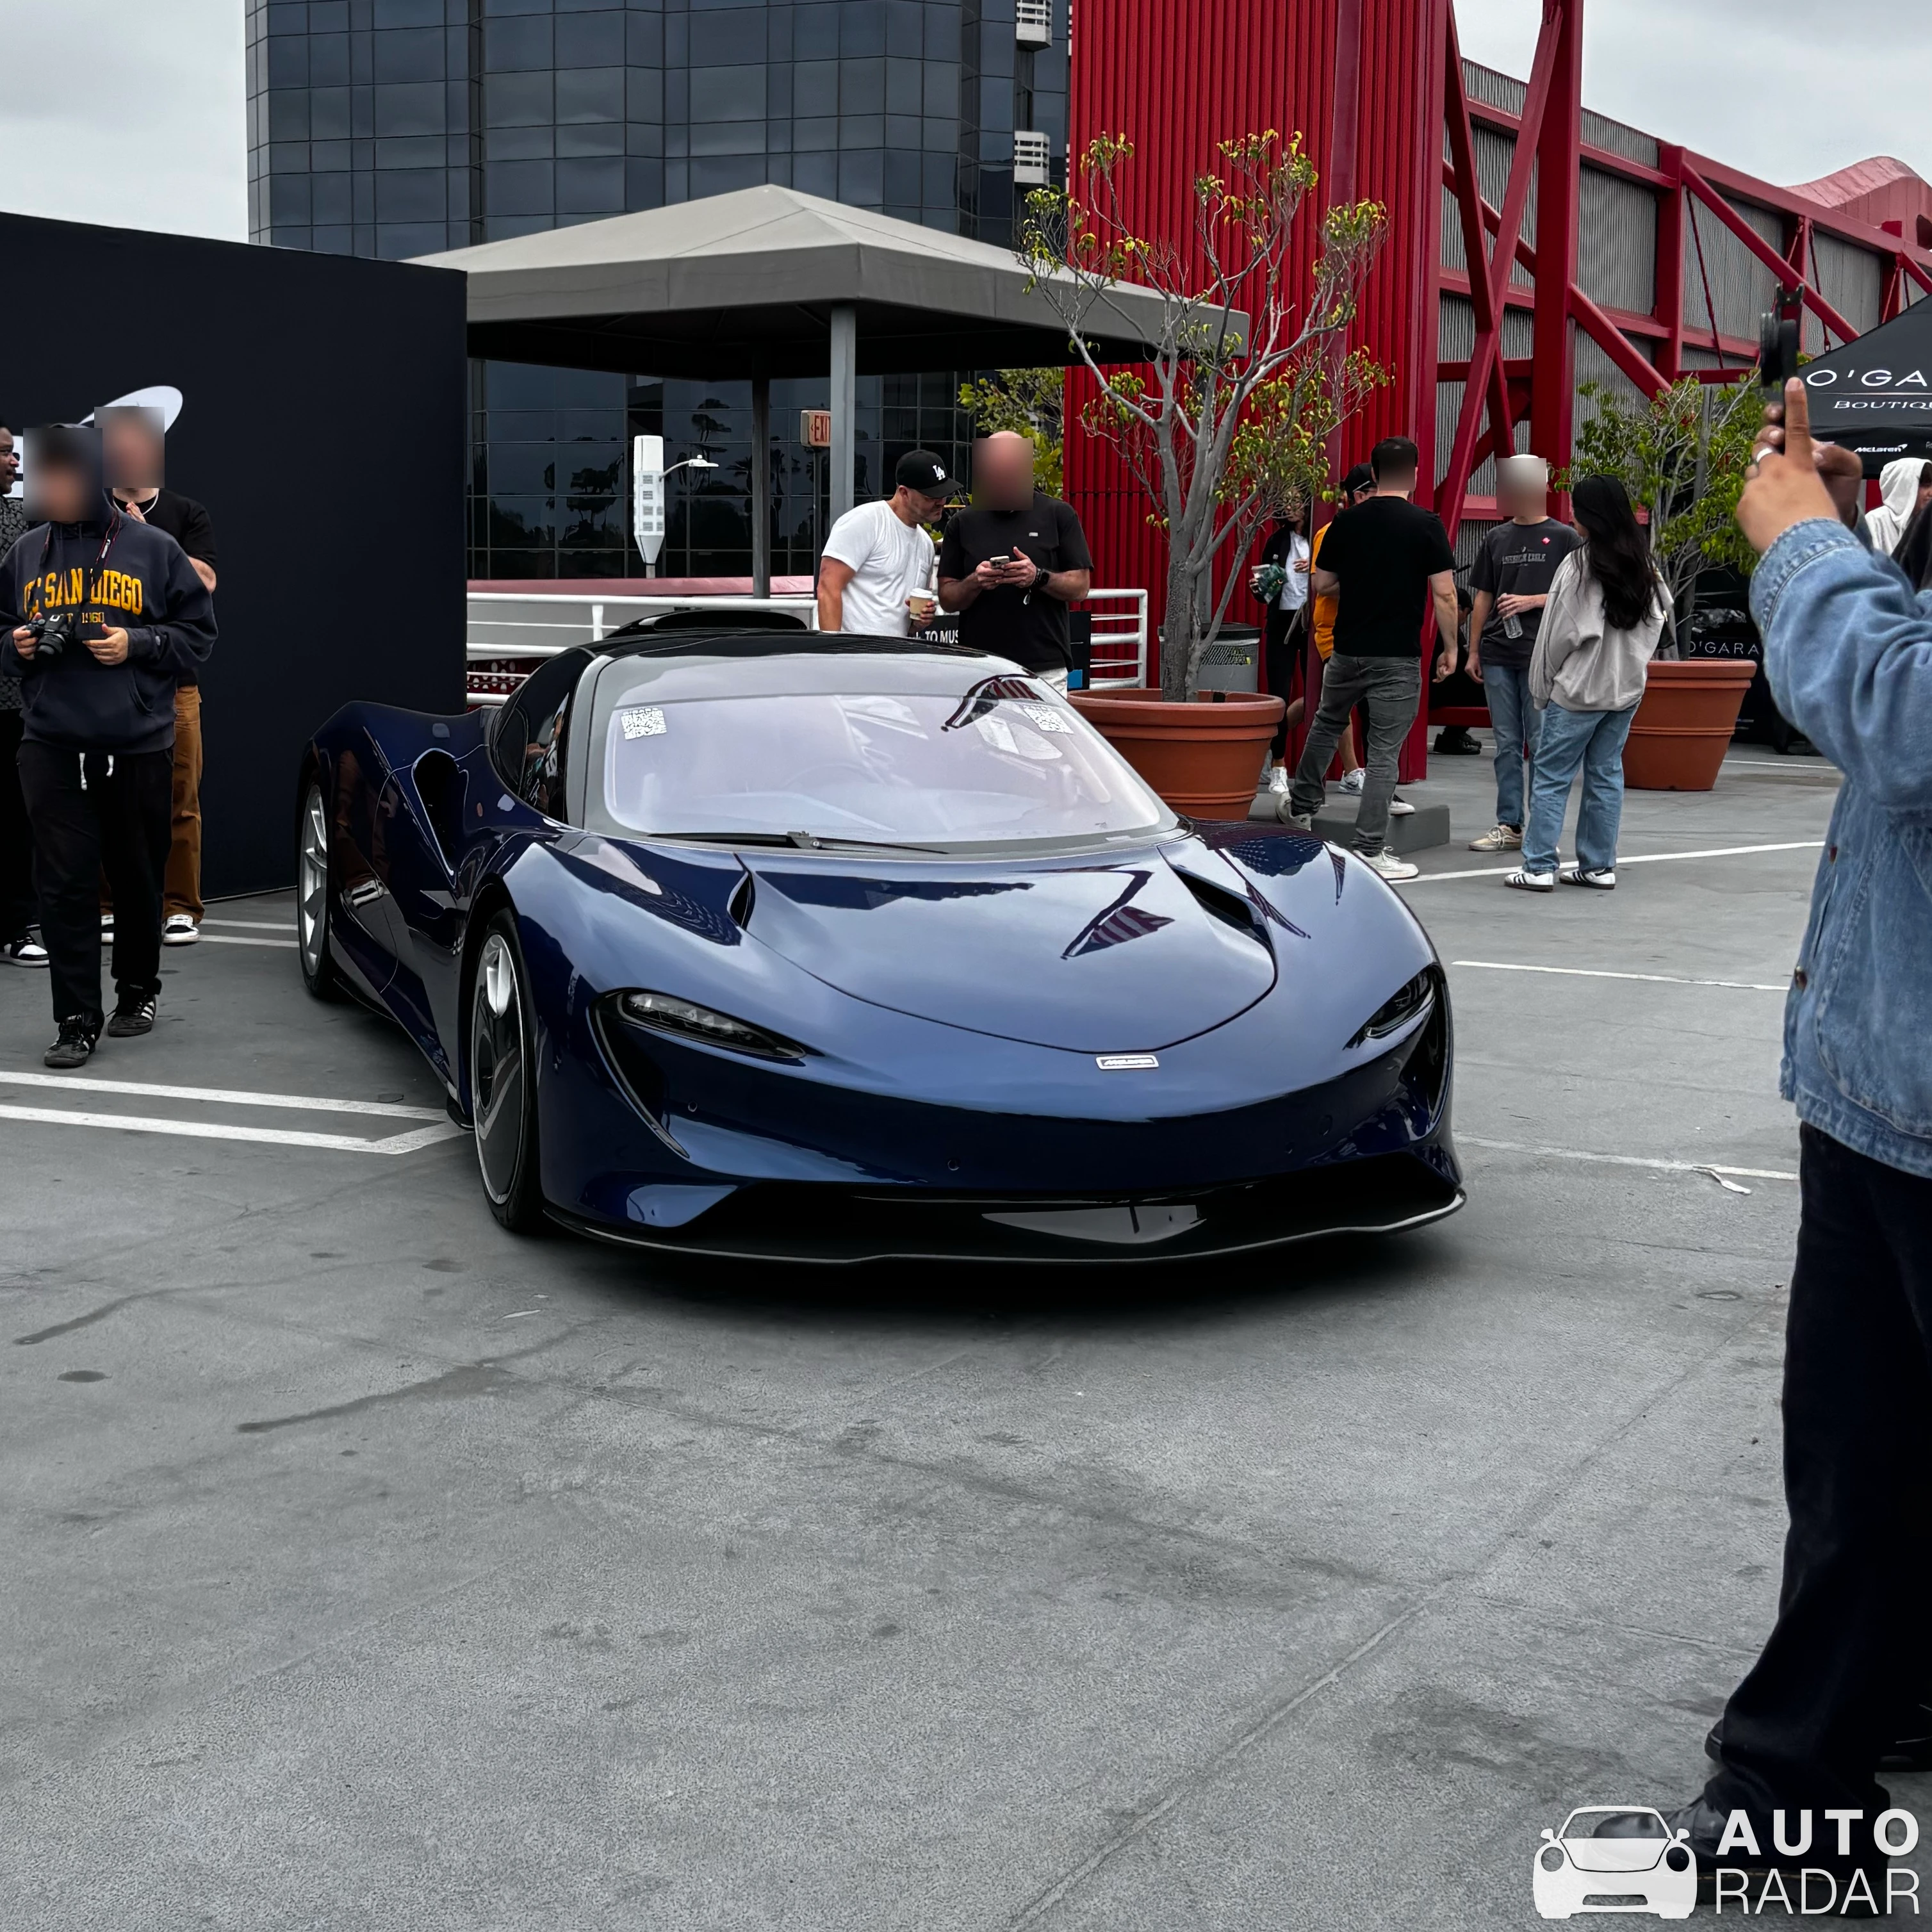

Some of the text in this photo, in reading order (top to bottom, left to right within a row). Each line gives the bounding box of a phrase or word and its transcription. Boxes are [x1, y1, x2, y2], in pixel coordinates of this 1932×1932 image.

[1806, 369, 1928, 386] O'GA
[1833, 400, 1932, 410] BOUTIQ
[933, 464, 946, 480] LA
[45, 568, 83, 609] SAN
[90, 568, 142, 615] DIEGO
